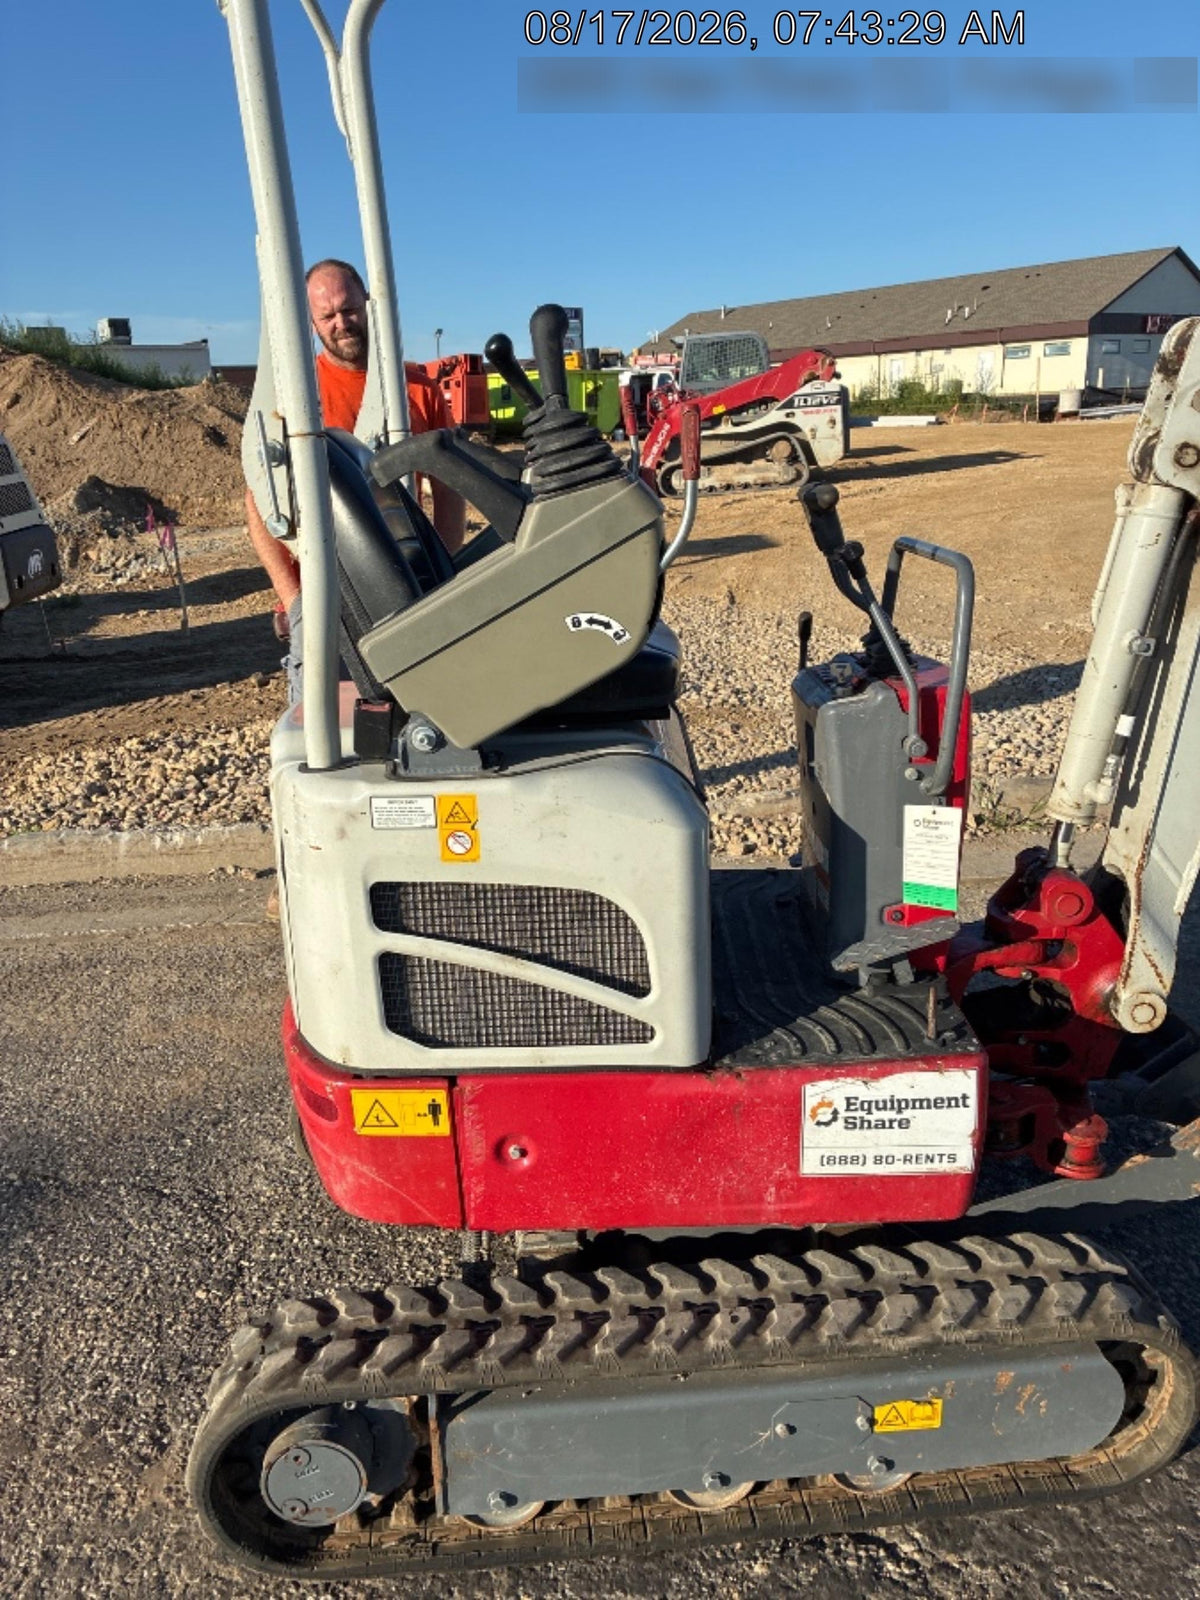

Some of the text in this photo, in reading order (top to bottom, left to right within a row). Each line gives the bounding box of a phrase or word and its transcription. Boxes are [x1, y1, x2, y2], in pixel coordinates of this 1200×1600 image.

[844, 1093, 970, 1115] Equipment
[843, 1116, 911, 1130] Share
[819, 1152, 957, 1167] (888) 80-RENTS
